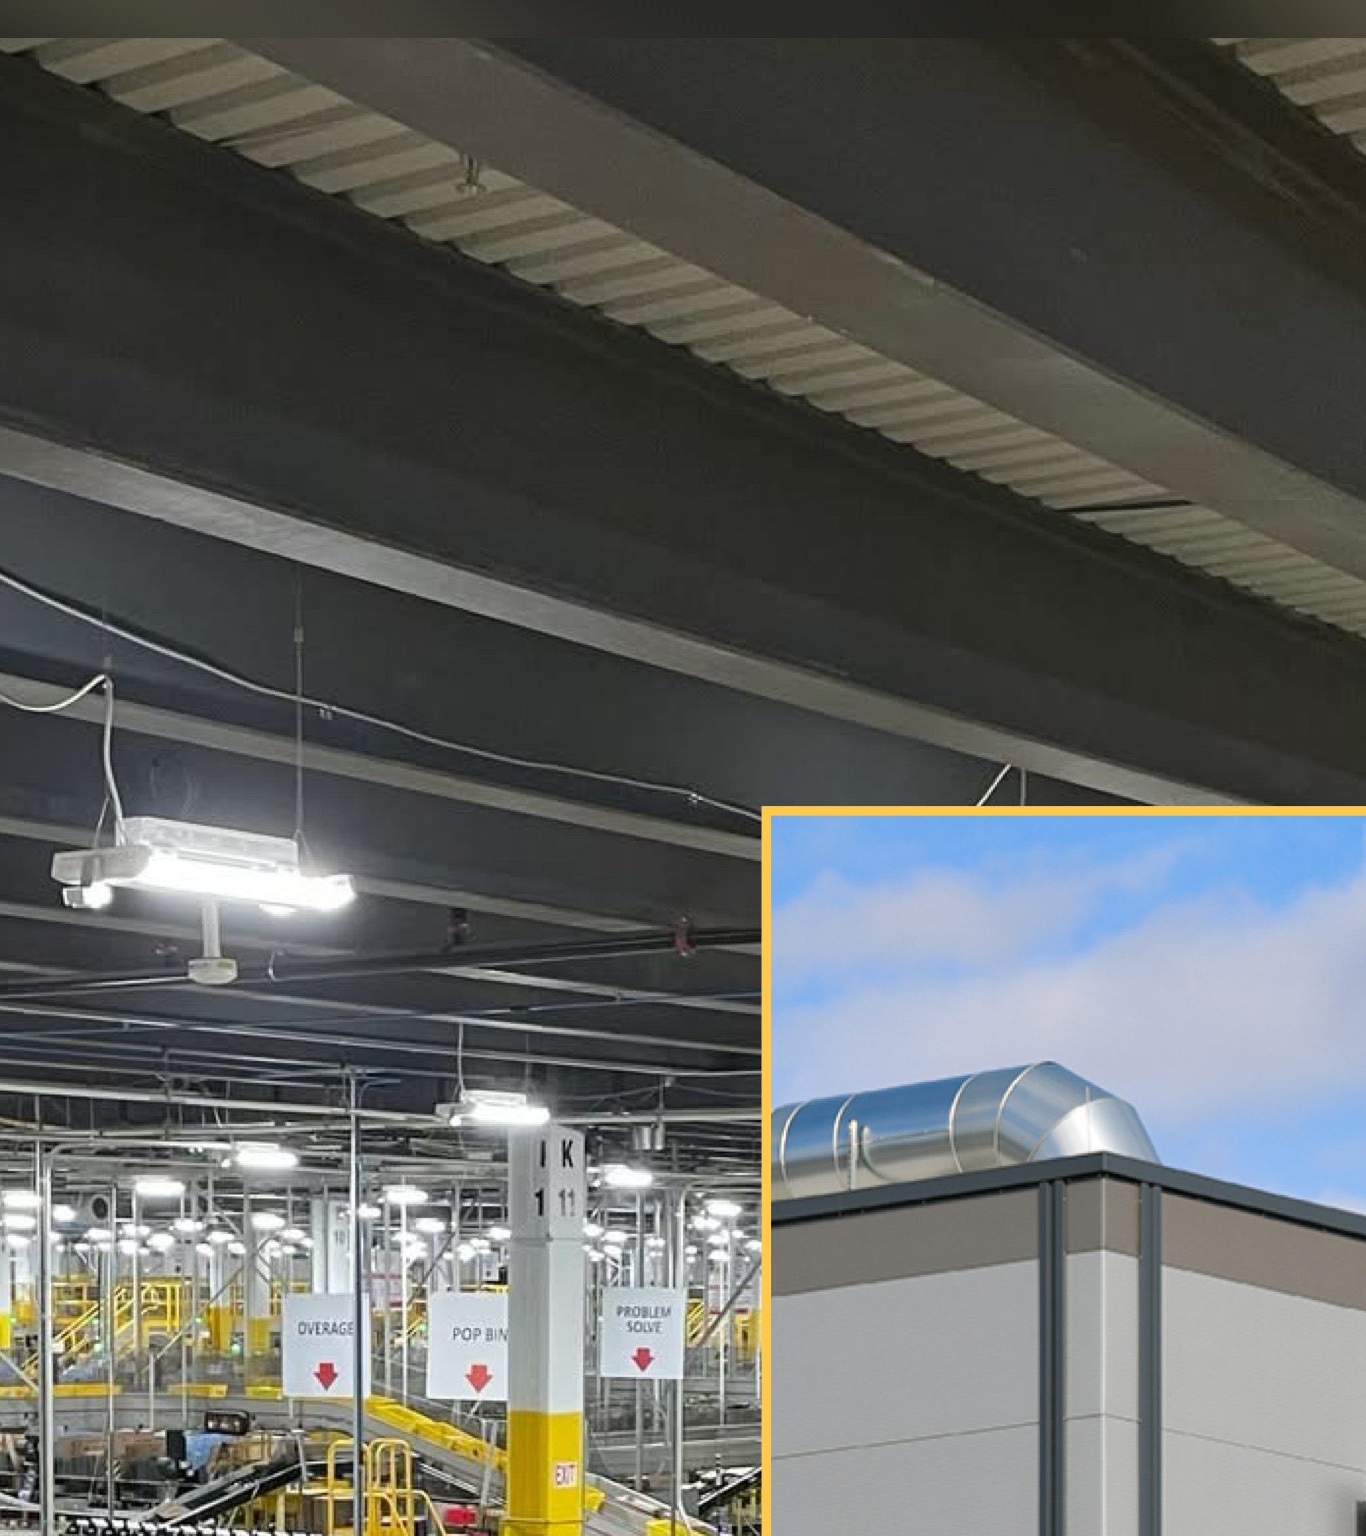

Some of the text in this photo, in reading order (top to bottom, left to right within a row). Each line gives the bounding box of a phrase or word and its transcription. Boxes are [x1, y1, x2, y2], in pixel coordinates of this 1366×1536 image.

[561, 1139, 574, 1168] K
[616, 1306, 671, 1318] PROBLEM
[297, 1322, 354, 1336] OVERAGE
[627, 1321, 662, 1333] SOLVE
[452, 1327, 509, 1343] POP BIN
